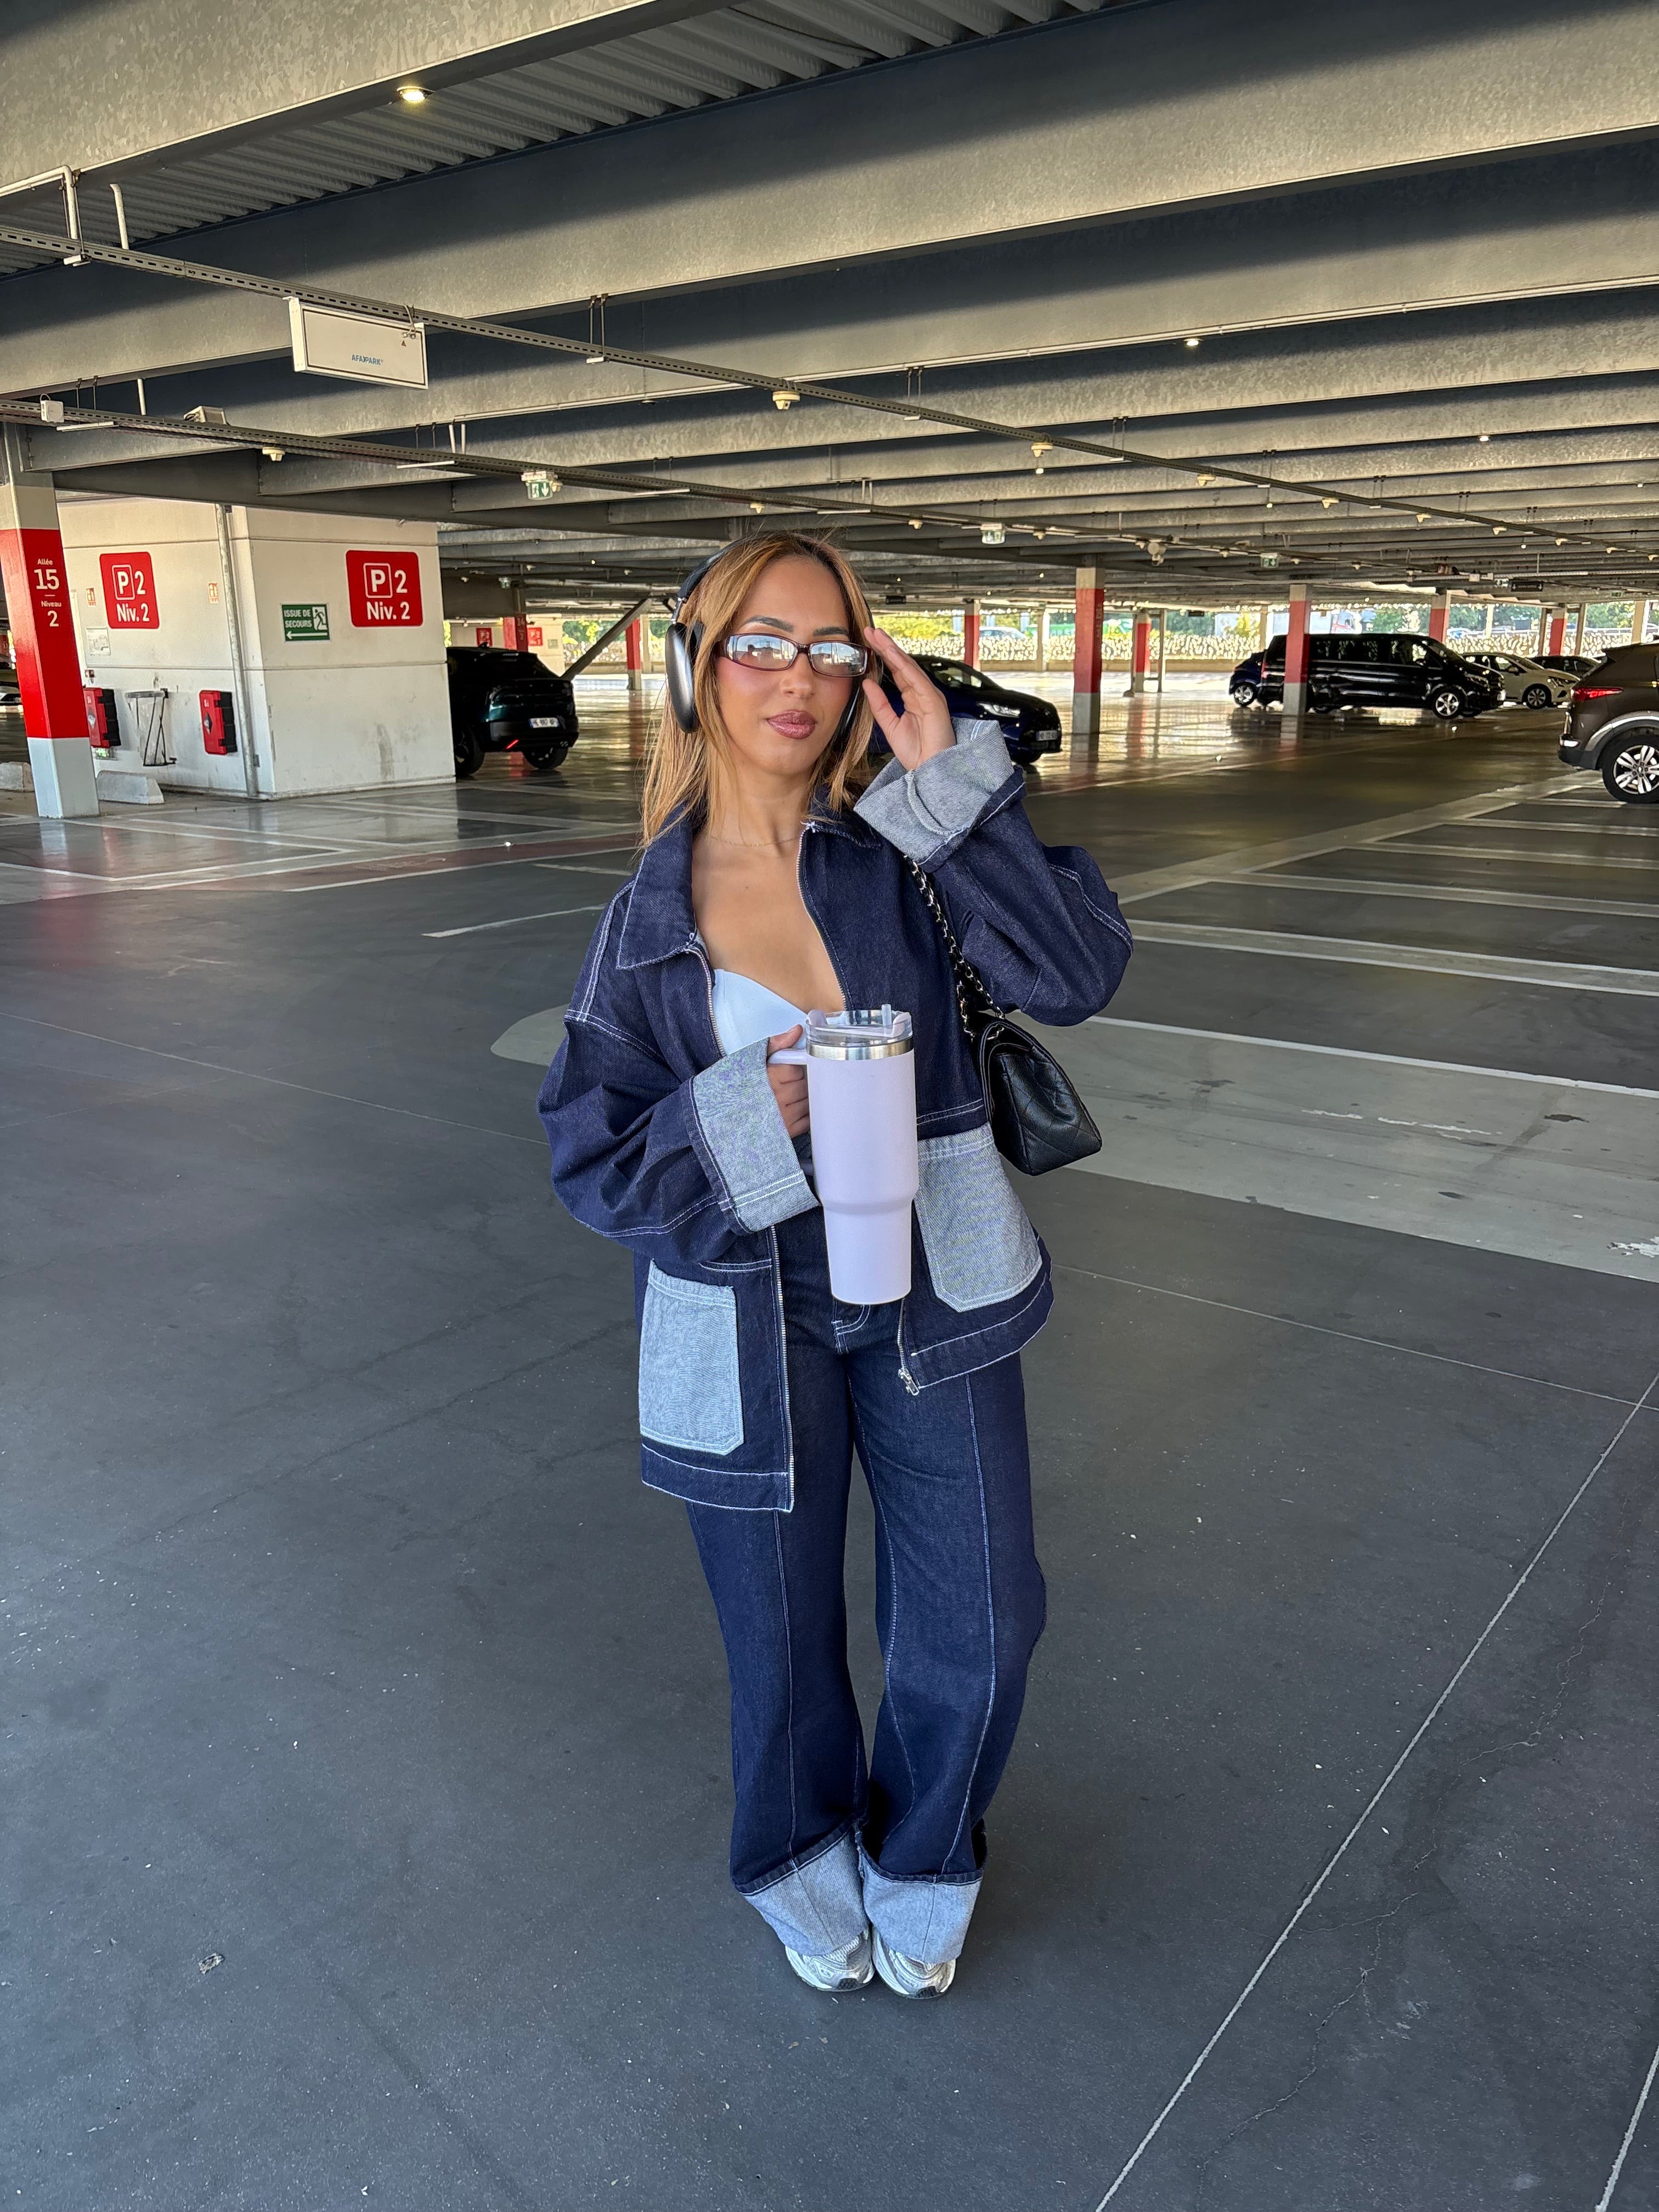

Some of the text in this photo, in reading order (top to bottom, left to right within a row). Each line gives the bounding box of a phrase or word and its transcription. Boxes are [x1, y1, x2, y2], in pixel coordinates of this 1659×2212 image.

[33, 568, 60, 590] 15
[117, 571, 146, 595] P 2
[370, 569, 408, 593] P 2
[47, 610, 59, 627] 2
[116, 602, 150, 622] Niv. 2
[284, 609, 311, 617] ISSUE DE
[366, 601, 410, 620] Niv. 2
[285, 619, 313, 628] SECOURS
